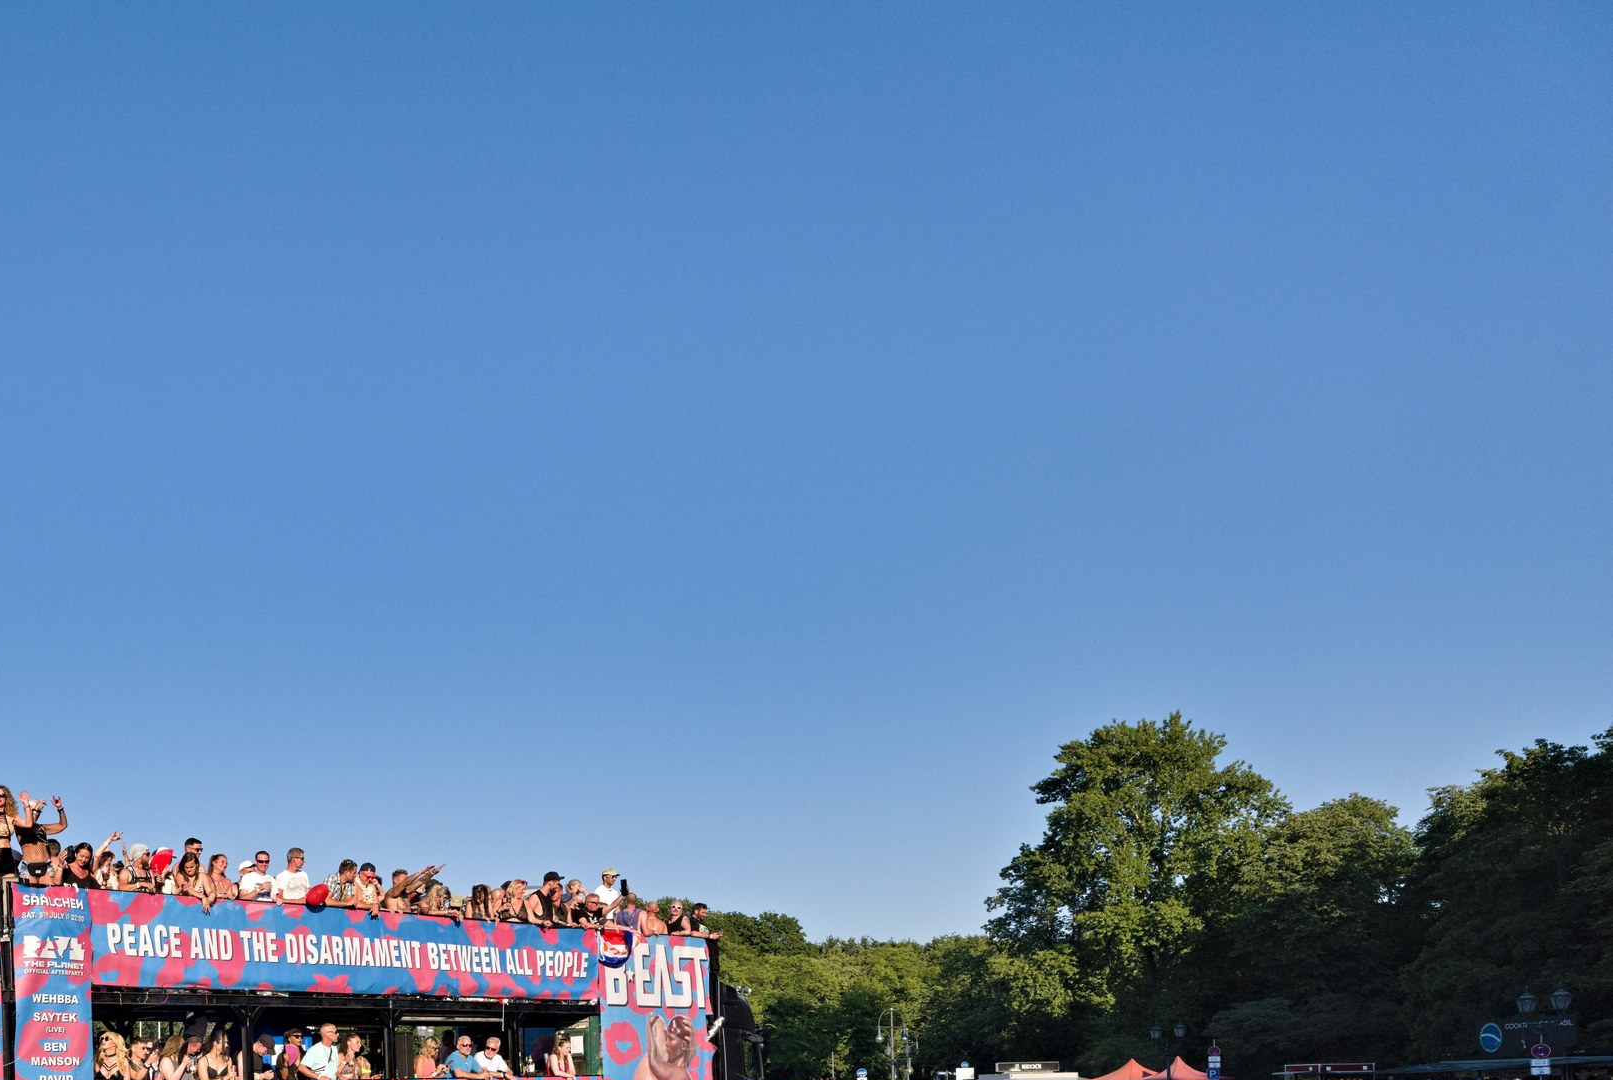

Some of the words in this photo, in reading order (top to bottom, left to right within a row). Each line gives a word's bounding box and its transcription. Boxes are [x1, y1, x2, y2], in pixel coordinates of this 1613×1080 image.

[22, 892, 84, 910] SÄÄLCHEN
[49, 912, 65, 920] JULY
[70, 914, 85, 923] 22:00
[107, 922, 183, 959] PEACE
[190, 927, 234, 962] AND
[240, 930, 280, 964] THE
[286, 933, 421, 969] DISARMAMENT
[427, 942, 502, 975] BETWEEN
[506, 949, 534, 976] ALL
[536, 950, 589, 979] PEOPLE
[24, 960, 45, 968] THE
[47, 961, 85, 970] PLANET
[32, 993, 79, 1004] WEHBBA
[33, 1012, 78, 1023] SAYTEK
[45, 1026, 65, 1034] (LIVE)
[43, 1042, 68, 1052] BEN
[31, 1056, 80, 1067] MANSON
